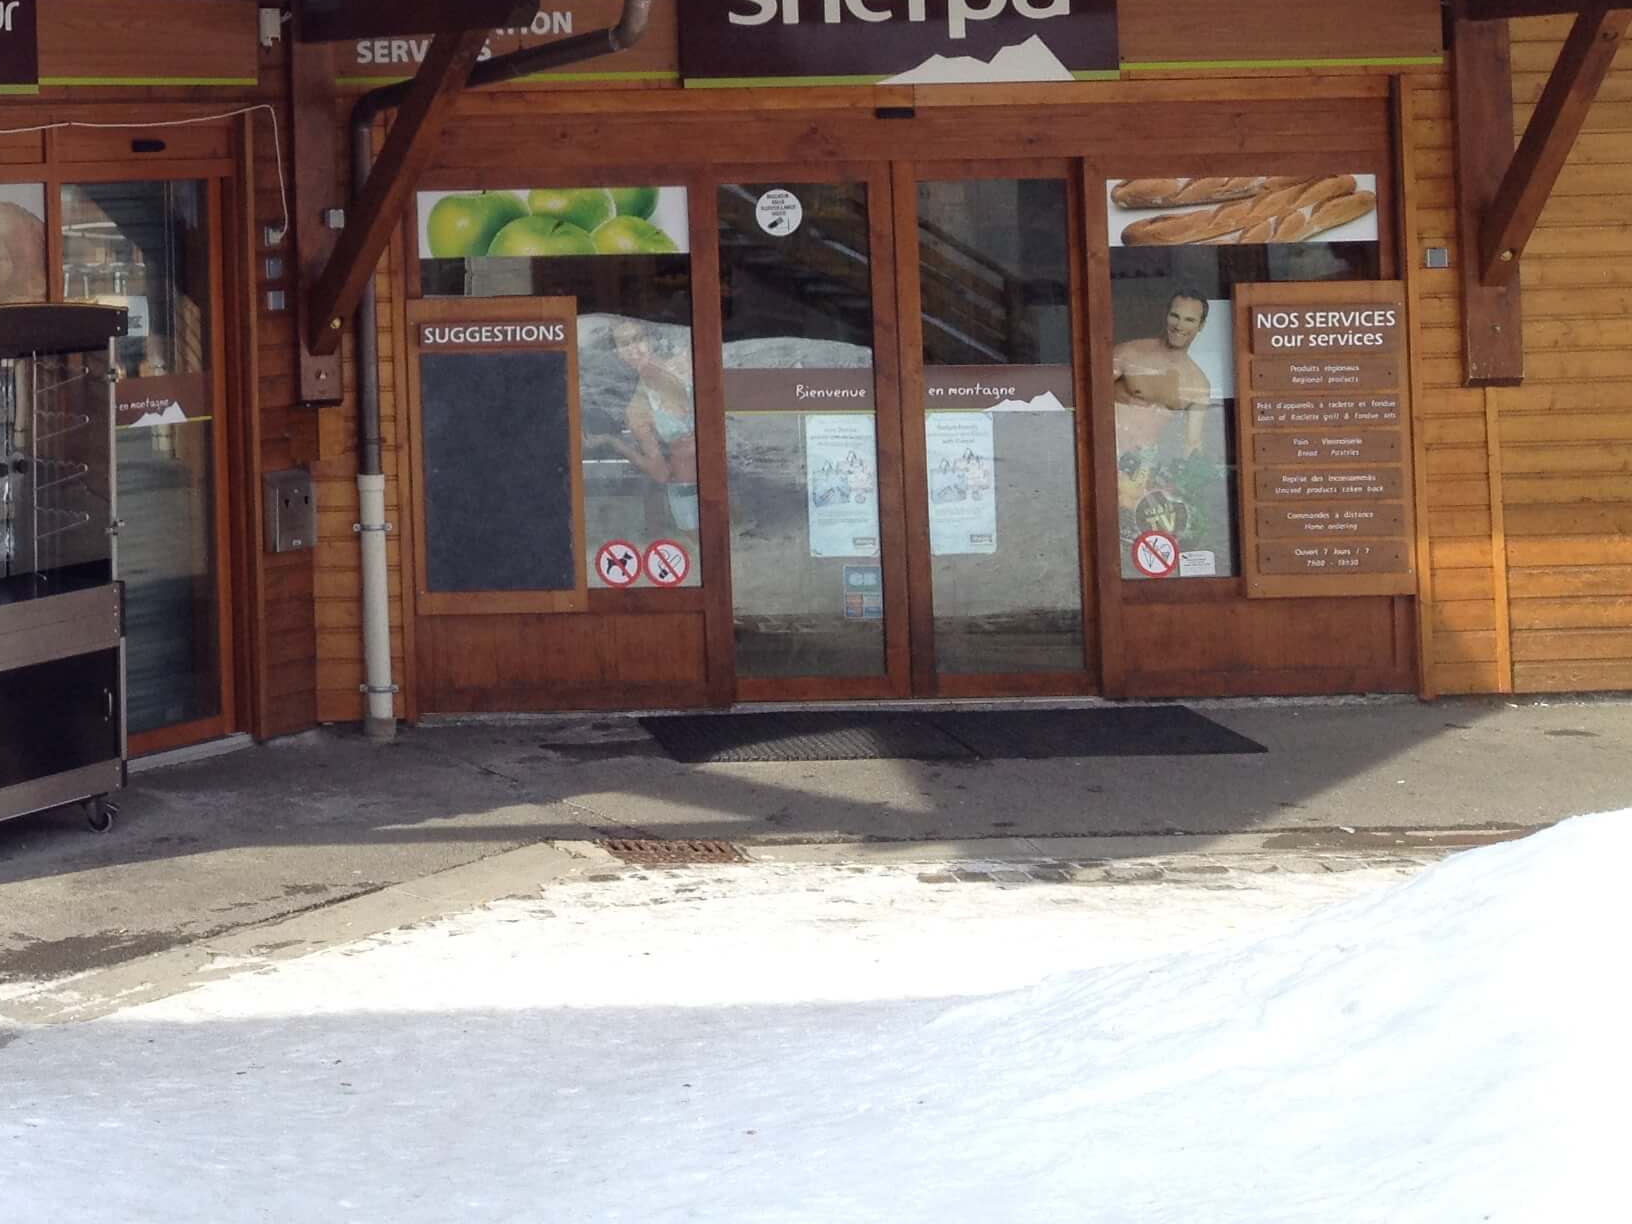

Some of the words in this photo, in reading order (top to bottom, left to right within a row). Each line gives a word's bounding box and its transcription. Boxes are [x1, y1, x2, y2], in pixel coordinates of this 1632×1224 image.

[1256, 312, 1300, 329] NOS
[1304, 310, 1397, 327] SERVICES
[423, 324, 566, 345] SUGGESTIONS
[1271, 334, 1305, 348] our
[1308, 330, 1384, 347] services
[795, 384, 867, 401] Bienvenue
[928, 385, 945, 396] en
[947, 382, 1016, 400] montagne
[119, 402, 129, 412] en
